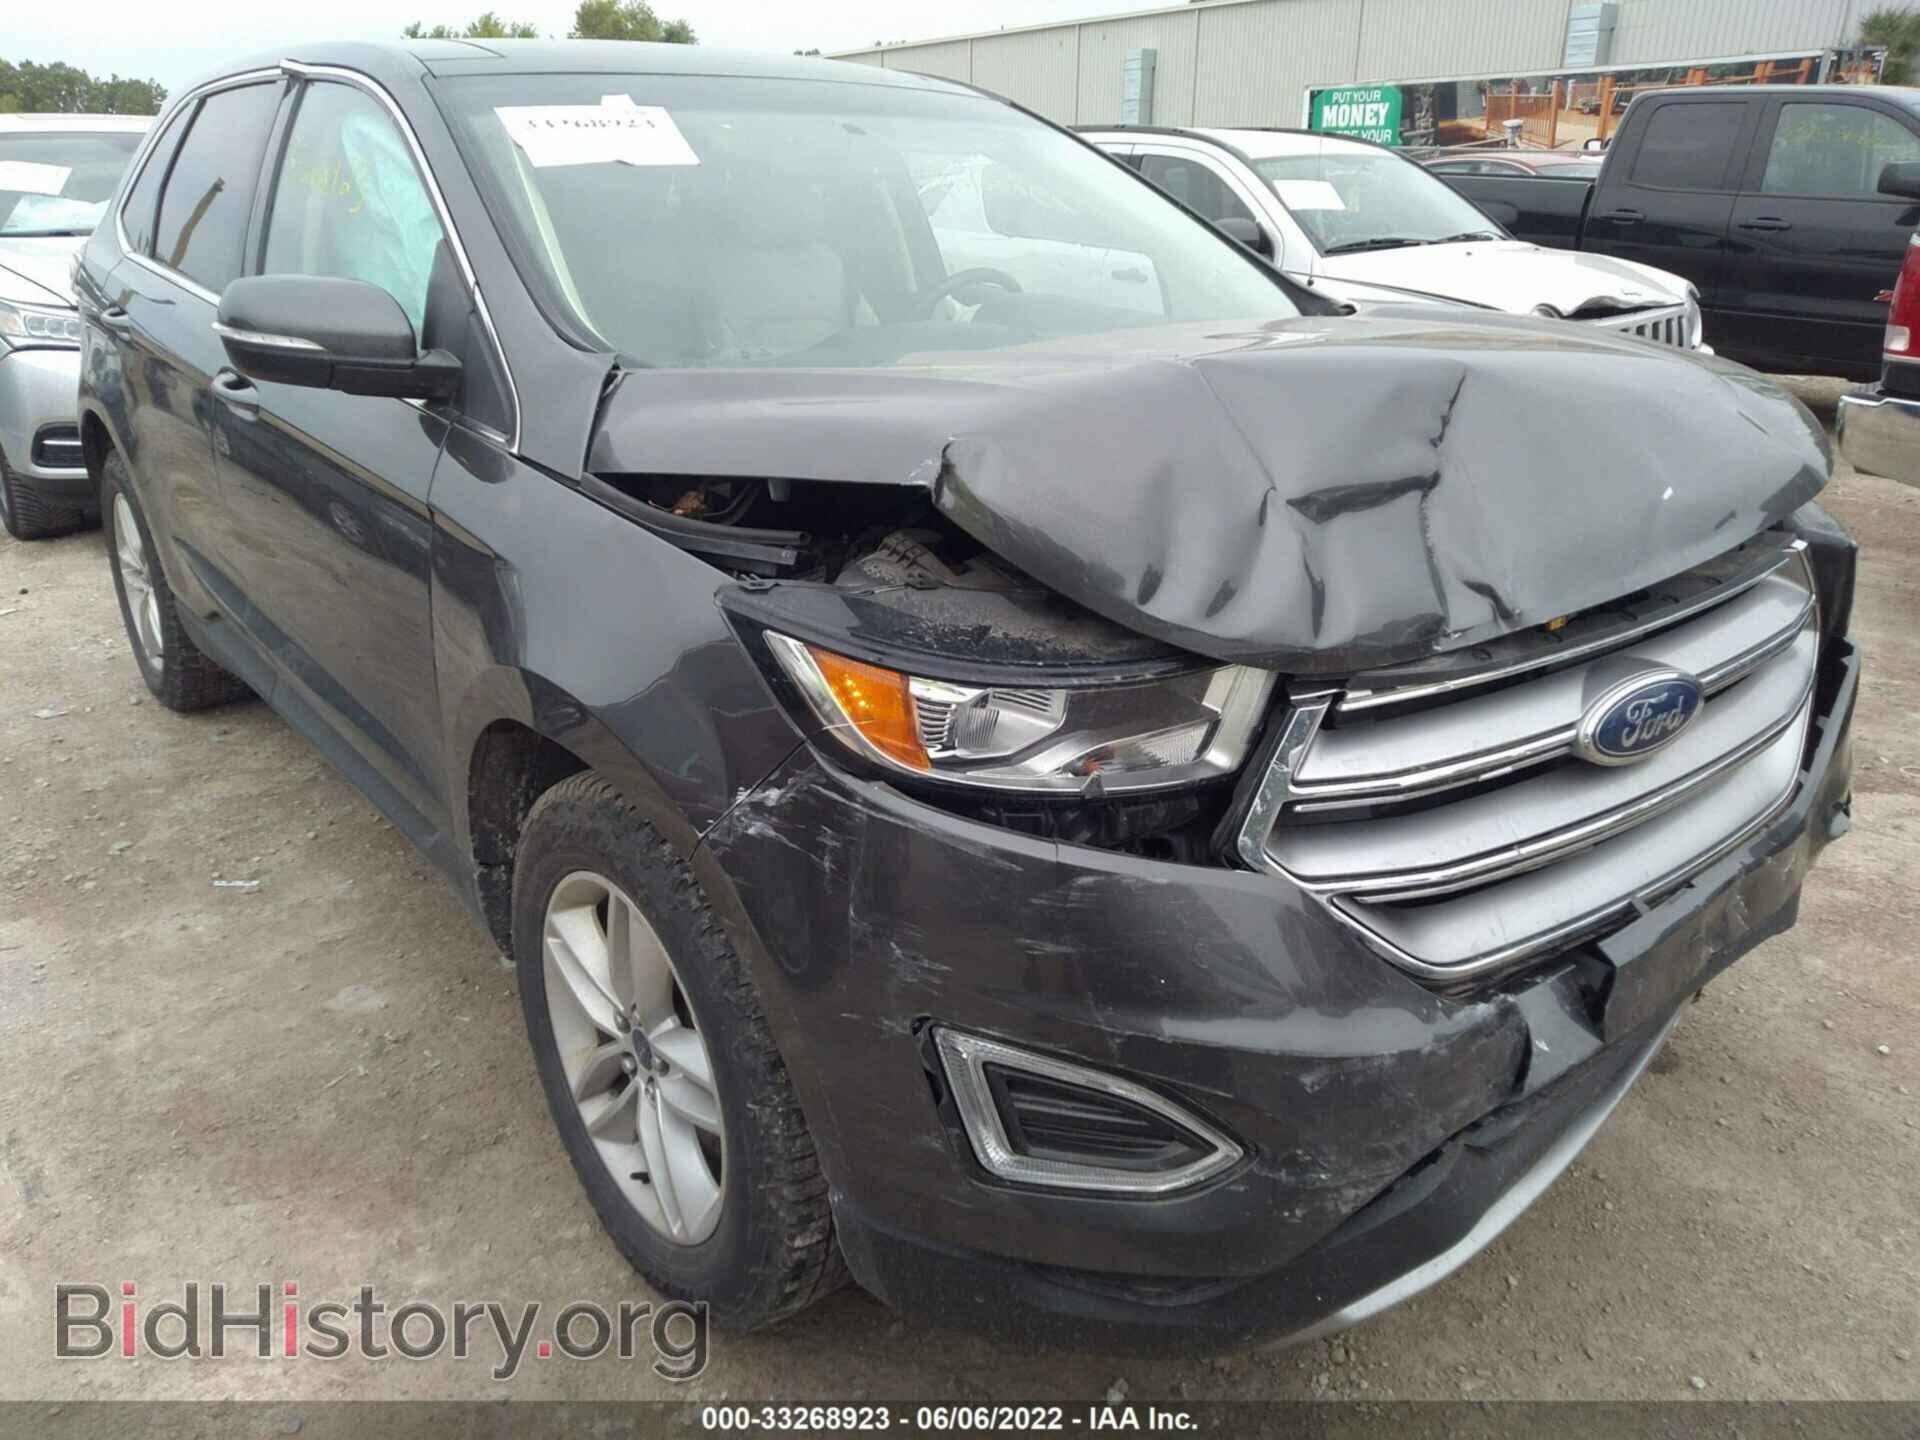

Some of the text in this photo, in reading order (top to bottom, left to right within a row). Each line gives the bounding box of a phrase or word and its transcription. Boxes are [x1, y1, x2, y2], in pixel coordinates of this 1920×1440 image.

[1332, 89, 1382, 103] PUT YOUR
[1322, 102, 1390, 128] MONEY
[1361, 129, 1392, 143] YOUR
[1621, 692, 1685, 748] Ford
